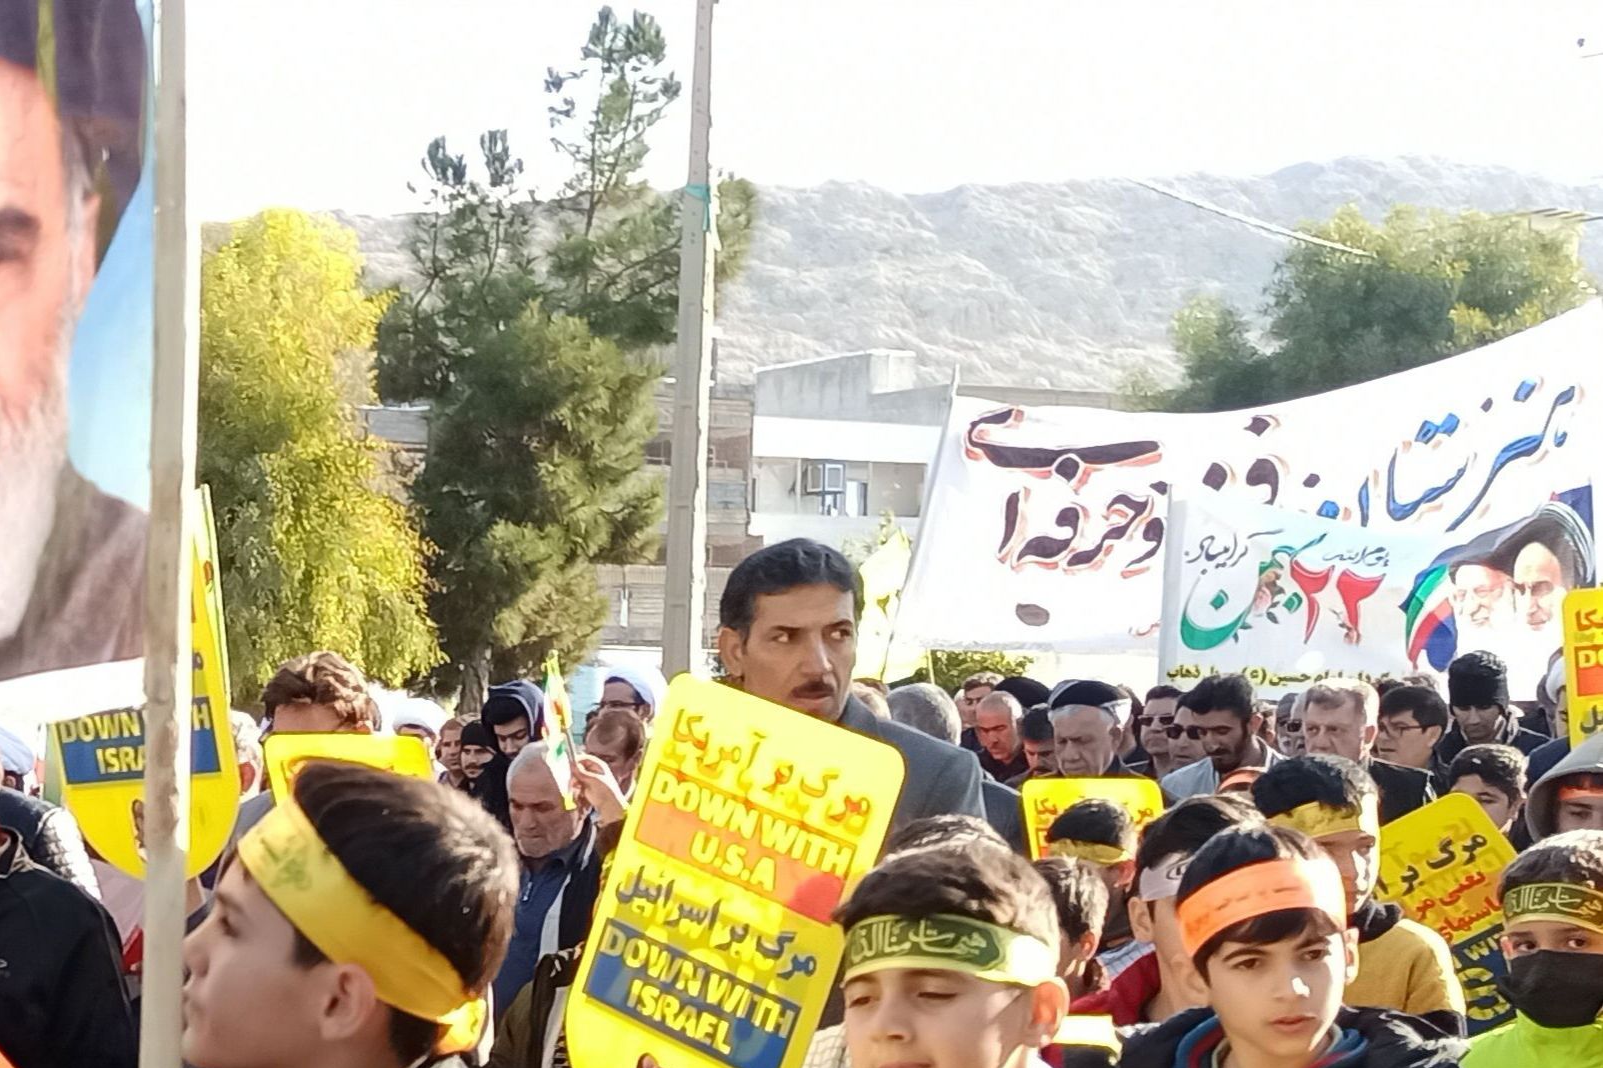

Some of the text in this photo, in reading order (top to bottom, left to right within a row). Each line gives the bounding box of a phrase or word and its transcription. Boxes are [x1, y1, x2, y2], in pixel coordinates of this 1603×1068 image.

[60, 711, 141, 744] DOWN
[672, 708, 768, 768] آمریکا
[650, 768, 855, 877] DOWN WITH
[800, 773, 871, 824] مرگ
[690, 829, 777, 892] U.S.A
[1426, 833, 1488, 866] مرگ
[616, 865, 722, 931] اسرائیل
[600, 924, 797, 1039] DOWN WITH
[756, 931, 818, 981] مرگ
[626, 979, 733, 1056] ISRAEL
